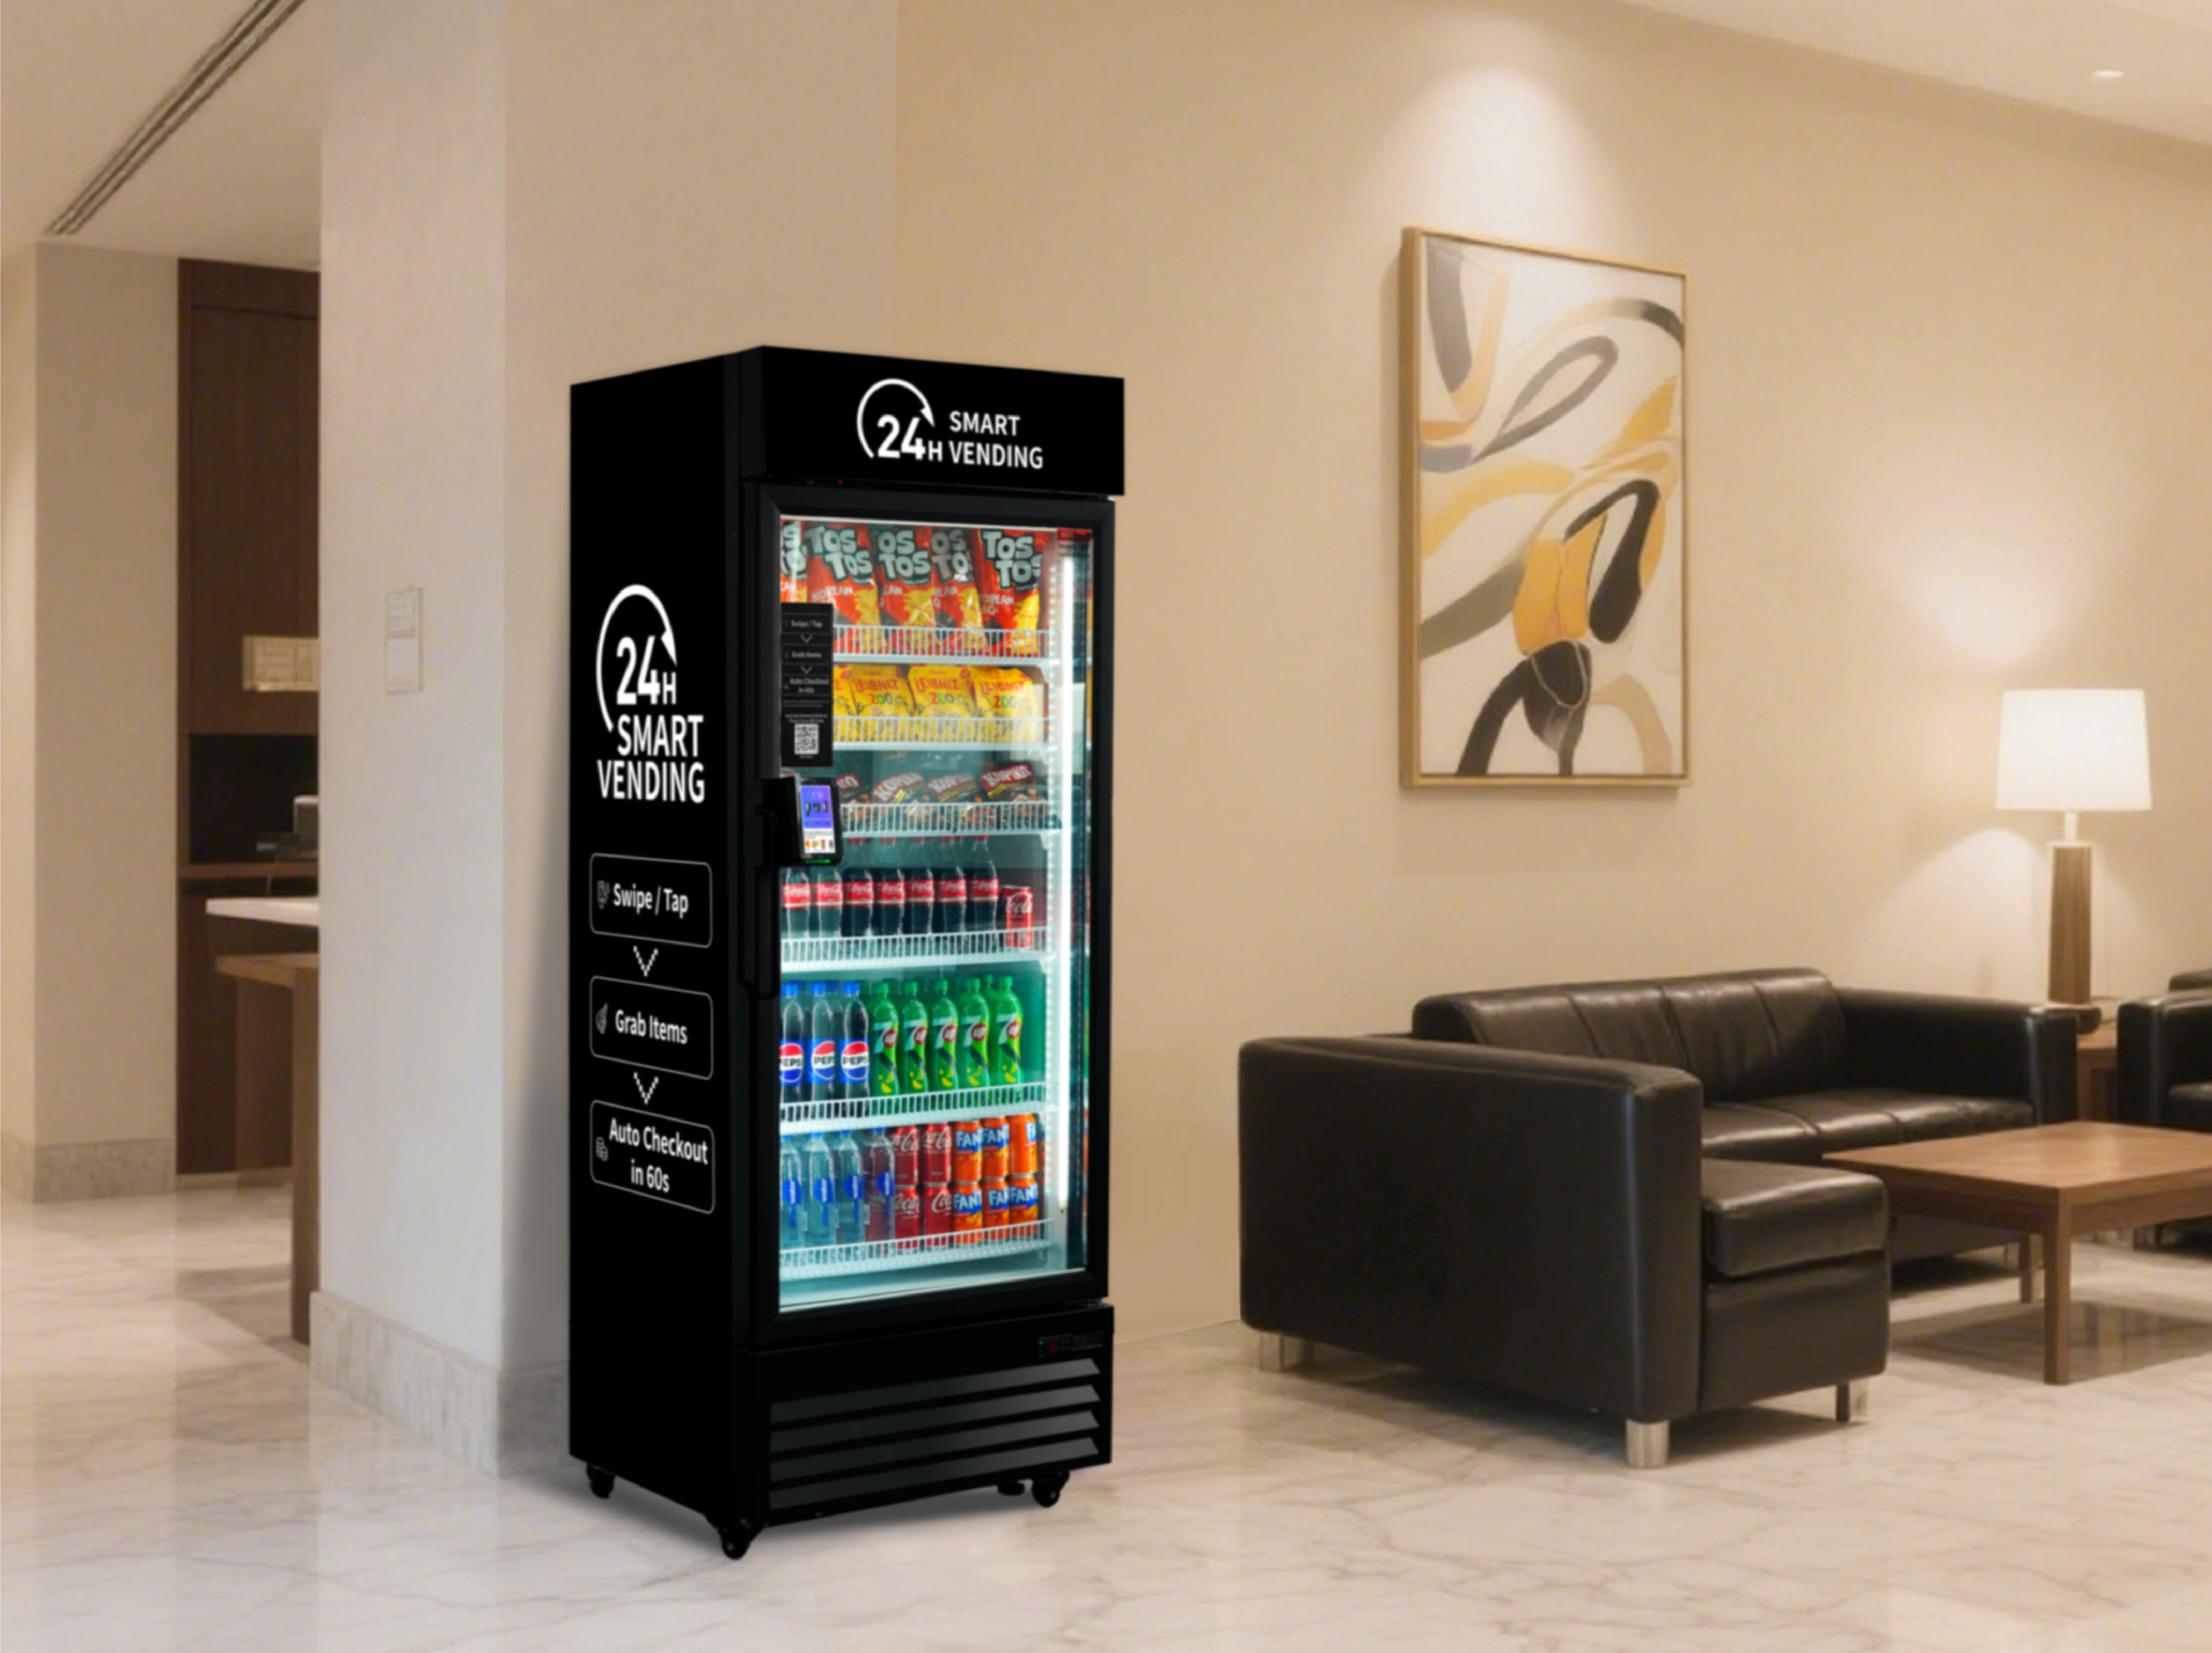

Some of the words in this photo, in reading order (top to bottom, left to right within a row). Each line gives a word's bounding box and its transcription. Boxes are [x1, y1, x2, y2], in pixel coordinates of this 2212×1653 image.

[950, 411, 1020, 436] SMART
[949, 440, 1043, 469] VENDING
[805, 525, 857, 554] TOS
[982, 531, 1033, 559] TOS
[824, 550, 873, 579] TOS
[878, 550, 931, 579] TOS
[853, 678, 900, 693] LEIBNIZ
[868, 692, 894, 705] ZOO
[913, 678, 961, 693] LEIBNIZ
[930, 691, 955, 705] ZOO
[979, 681, 1026, 696] LEIBNIZ
[993, 695, 1017, 709] ZOO
[617, 714, 704, 758] SMART
[596, 760, 705, 804] VENDING
[613, 883, 653, 914] Swipe
[655, 887, 661, 915] /
[663, 888, 689, 918] Tap
[615, 1009, 647, 1036] Grab
[649, 1015, 688, 1044] Items
[609, 1118, 640, 1146] Auto
[643, 1125, 709, 1165] Checkout
[631, 1158, 644, 1185] in
[646, 1165, 670, 1192] 60s
